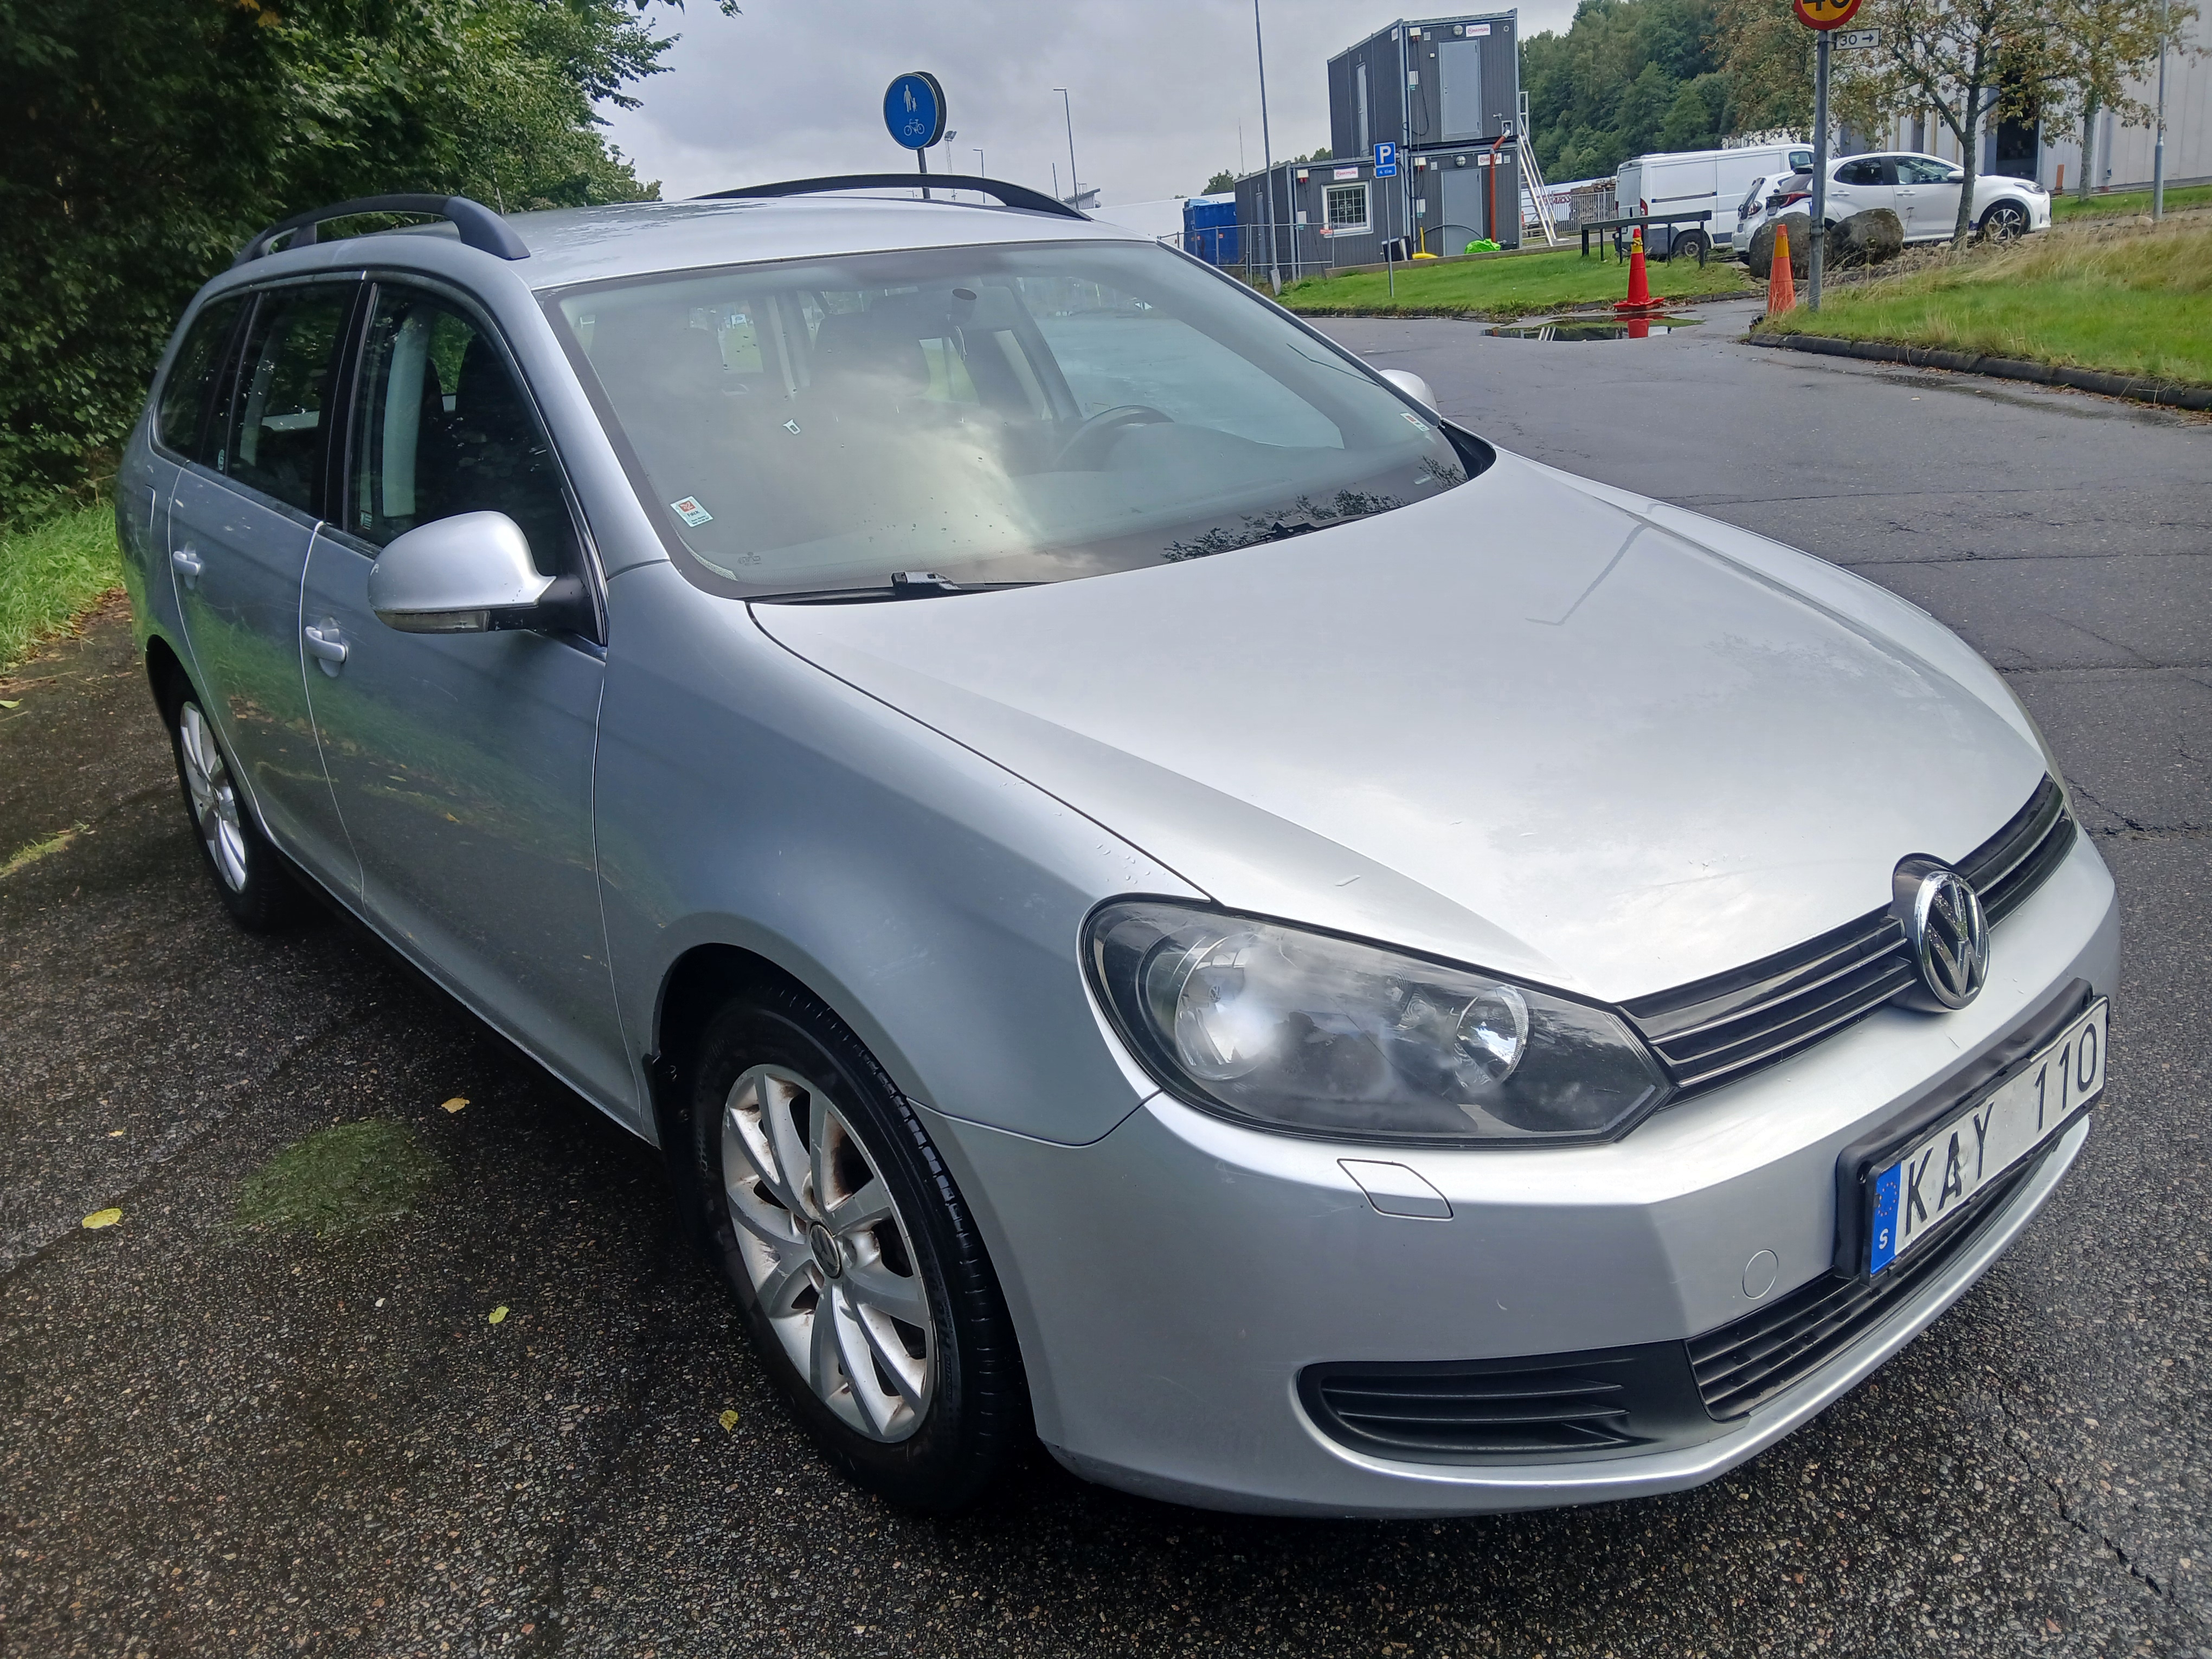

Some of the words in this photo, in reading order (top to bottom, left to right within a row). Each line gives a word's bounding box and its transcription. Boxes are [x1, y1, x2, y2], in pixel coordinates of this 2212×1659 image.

[1840, 35, 1857, 46] 30
[1380, 145, 1391, 164] P
[1904, 1101, 1995, 1238] KAY
[2034, 1023, 2097, 1134] 110
[1879, 1228, 1888, 1250] S
